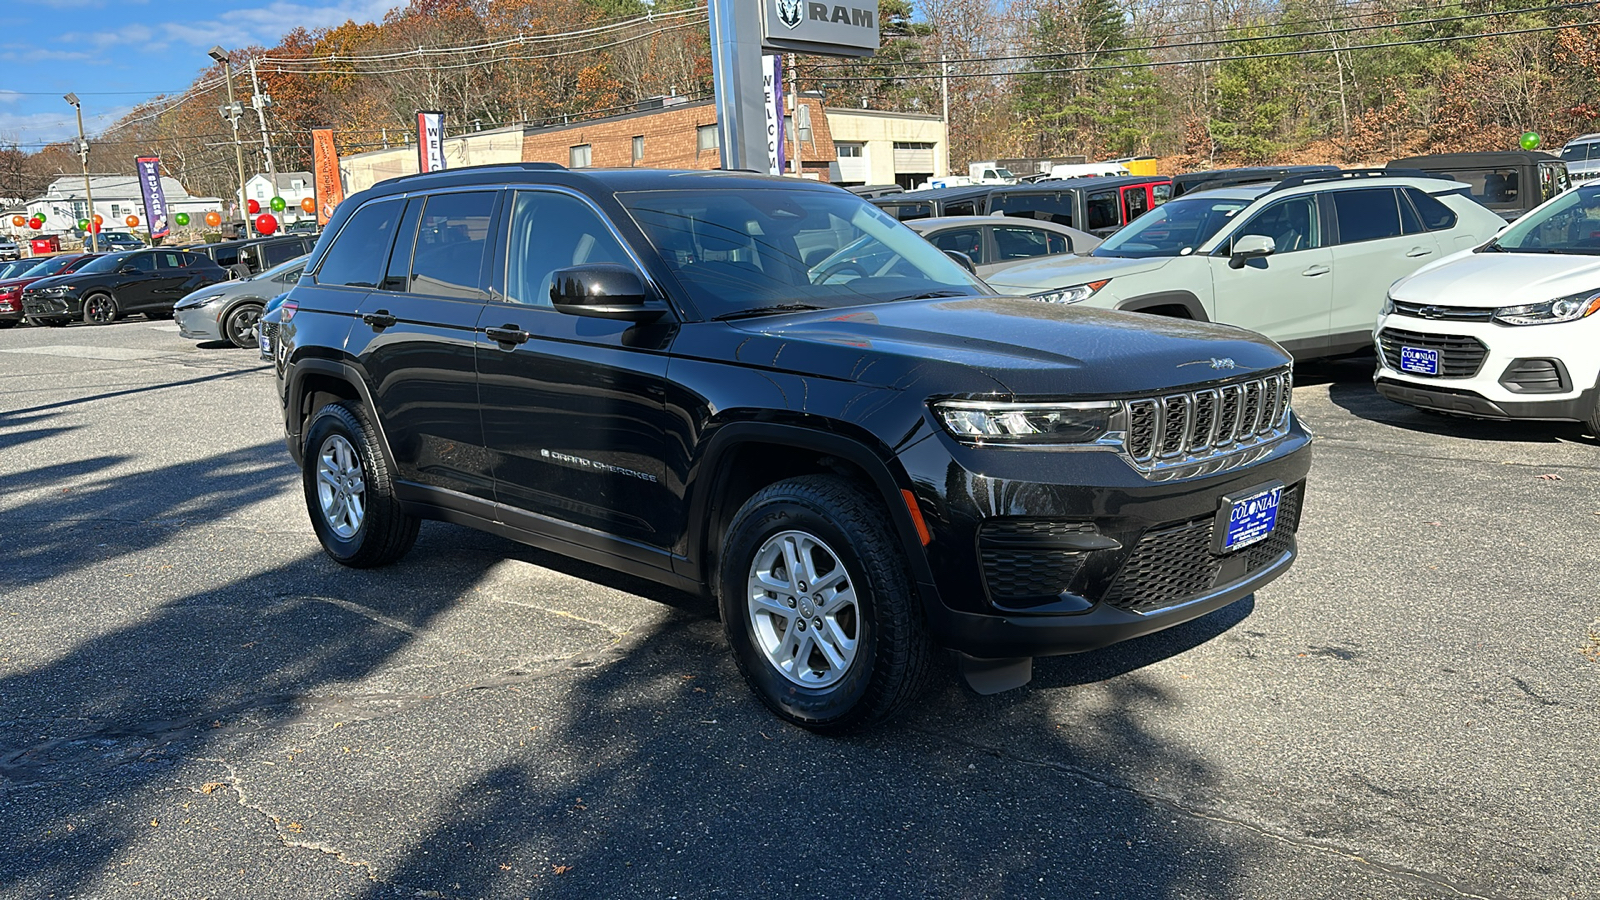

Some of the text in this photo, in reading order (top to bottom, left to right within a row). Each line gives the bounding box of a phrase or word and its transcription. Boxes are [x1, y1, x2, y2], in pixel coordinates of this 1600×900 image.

[808, 2, 873, 28] RAM
[144, 163, 162, 215] WE BUY CARS
[324, 174, 332, 204] Certified
[1402, 350, 1435, 361] COLONIAL
[551, 451, 657, 482] GRAND CHEROKEE
[1230, 490, 1279, 522] COLONIAL
